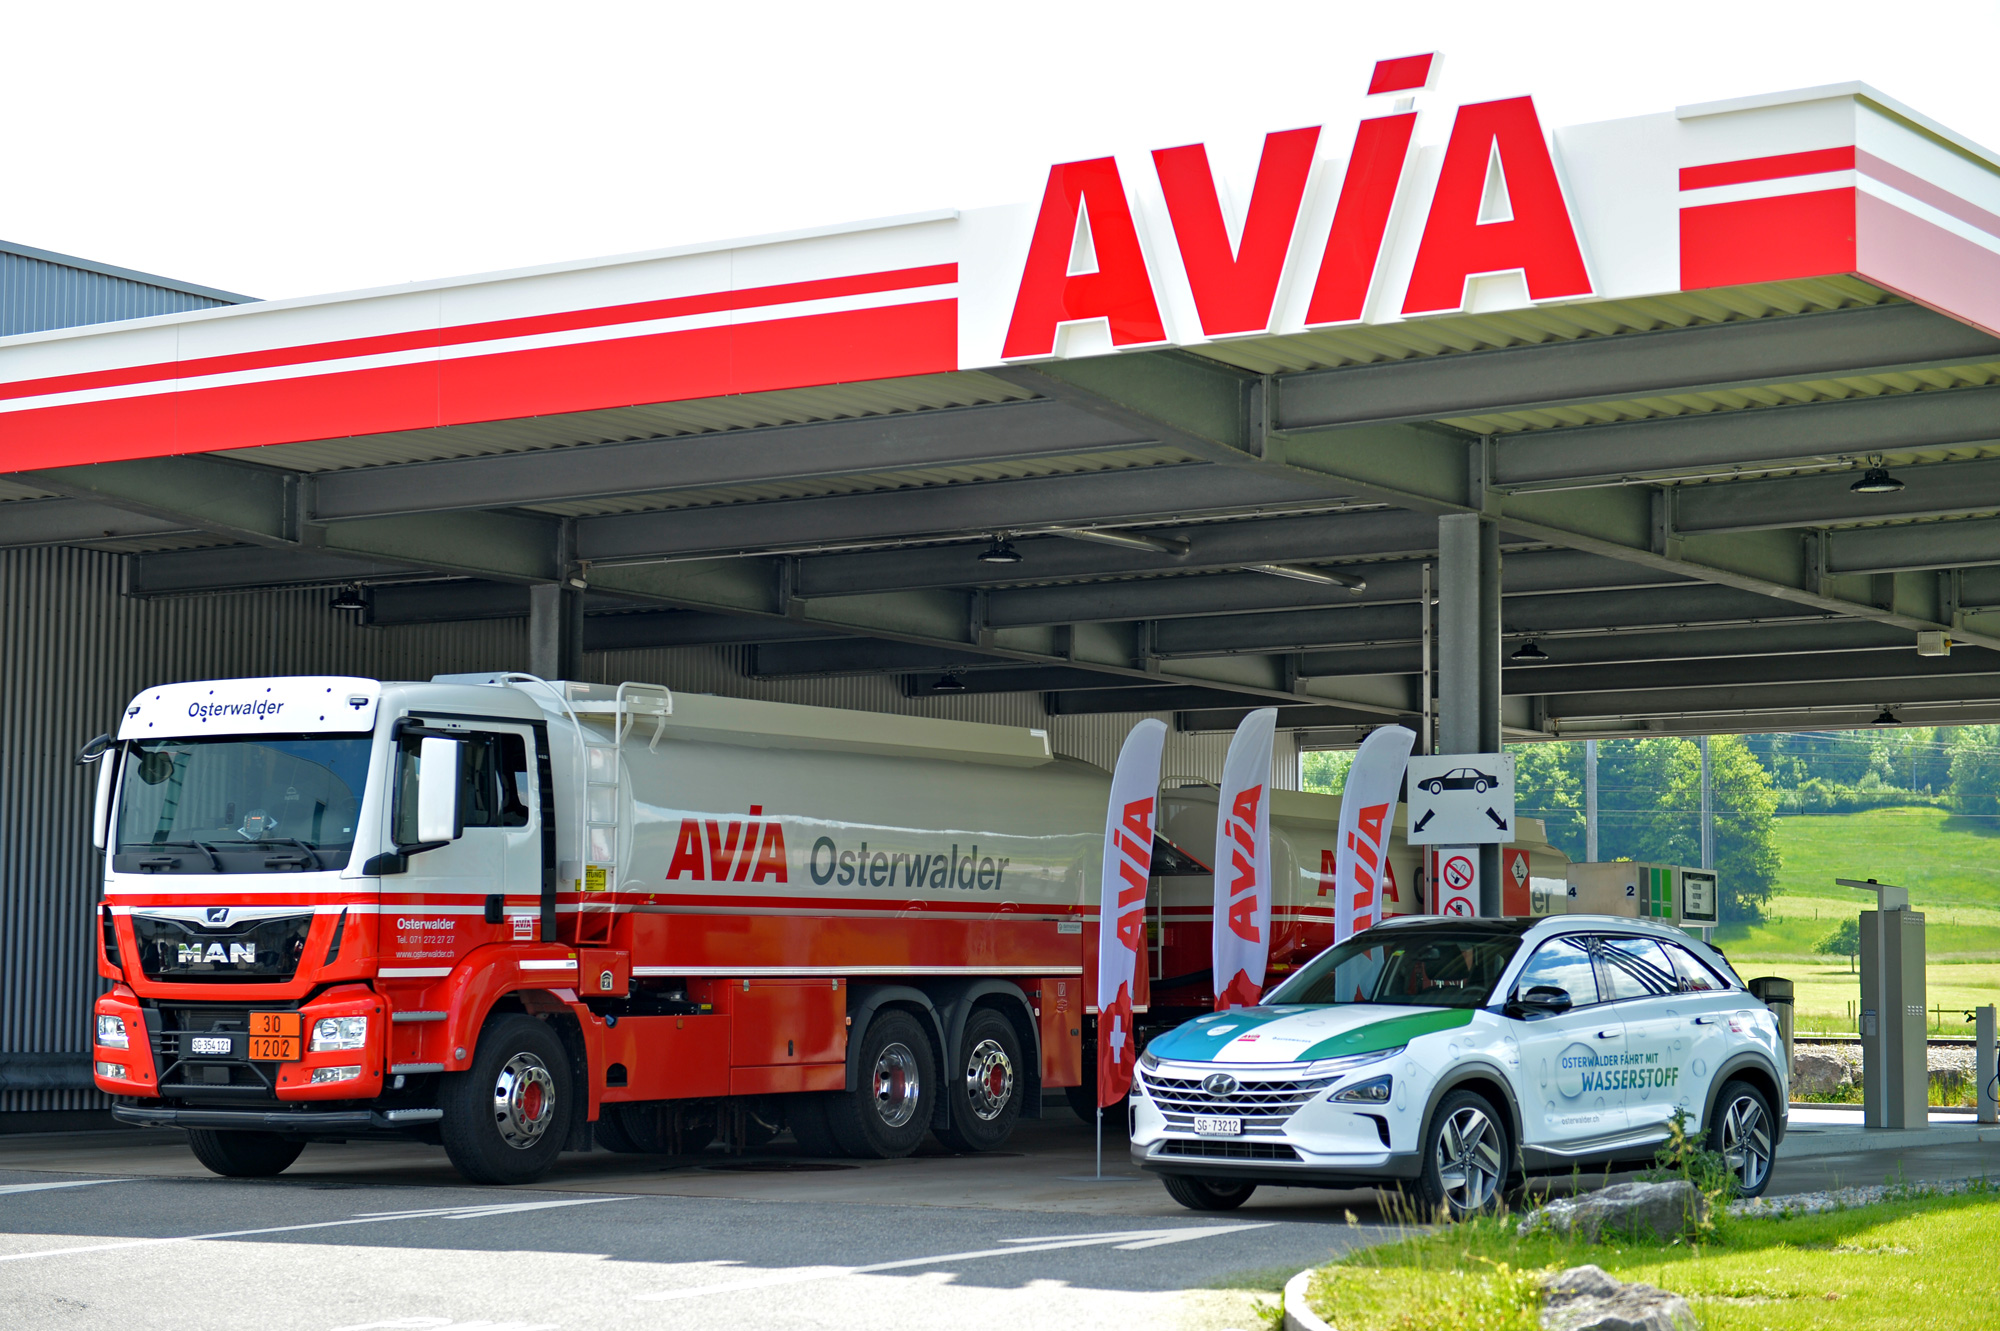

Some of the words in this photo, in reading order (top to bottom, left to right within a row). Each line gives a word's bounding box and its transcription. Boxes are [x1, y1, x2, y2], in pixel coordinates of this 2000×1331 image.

[1001, 51, 1597, 361] AVIA
[188, 699, 284, 717] Osterwalder
[665, 804, 788, 883] AVIA
[810, 836, 1009, 890] Osterwalder
[1225, 783, 1262, 943] AVIA
[1114, 796, 1154, 953] AVIA
[1569, 887, 1576, 897] 4
[1626, 886, 1635, 896] 2
[397, 917, 455, 929] Osterwalder
[396, 935, 408, 944] Tel.
[409, 935, 421, 944] 071
[423, 935, 436, 944] 272
[437, 935, 446, 944] 27
[446, 935, 455, 944] 27
[178, 943, 256, 963] MAN
[396, 950, 455, 959] www.osterwalder.ch
[264, 1015, 281, 1033] 30
[254, 1039, 290, 1057] 1202
[1562, 1055, 1618, 1069] OSTERWALDER
[1620, 1051, 1644, 1065] FÄHRT
[1646, 1053, 1659, 1064] MIT
[1582, 1067, 1679, 1092] WASSERSTOFF
[1561, 1115, 1600, 1125] osterwalder.ch
